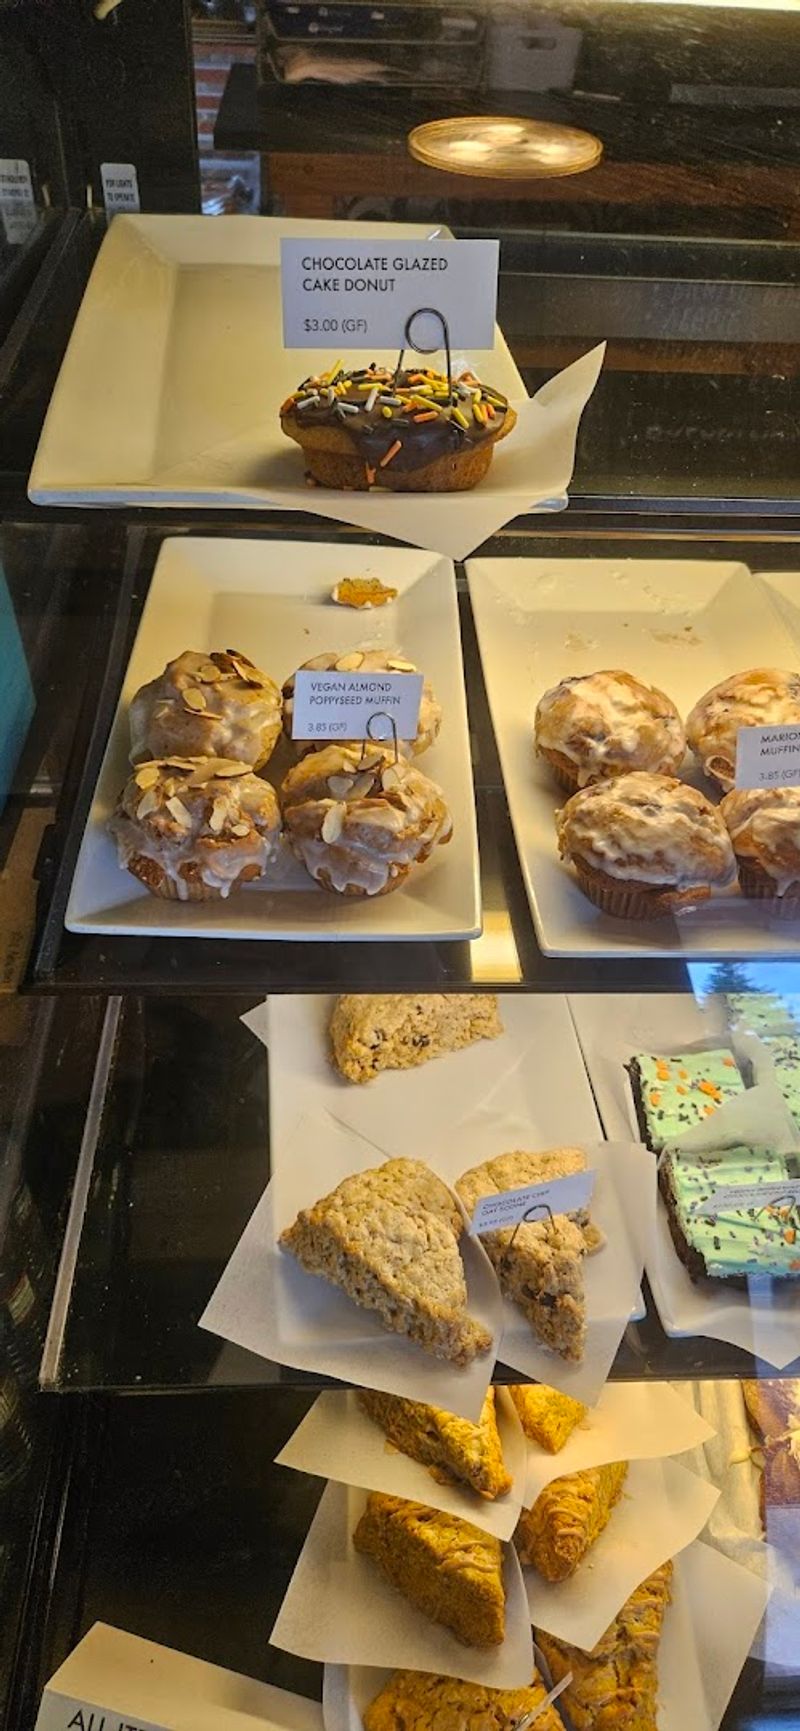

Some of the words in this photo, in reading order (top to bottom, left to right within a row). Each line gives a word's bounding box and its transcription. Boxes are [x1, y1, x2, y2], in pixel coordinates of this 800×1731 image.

[302, 256, 388, 272] CHOCOLATE
[392, 256, 449, 272] GLAZED
[302, 278, 340, 292] CAKE
[344, 278, 396, 292] DONUT
[304, 318, 338, 333] $3.00
[341, 318, 369, 334] (GF)
[310, 682, 346, 692] VEGAN
[347, 682, 393, 692] ALMOND
[309, 695, 362, 706] POPPYSEED
[364, 695, 401, 705] MUFFIN
[307, 722, 327, 733] 3.85
[328, 722, 348, 733] (GF)
[760, 732, 800, 744] MARIO
